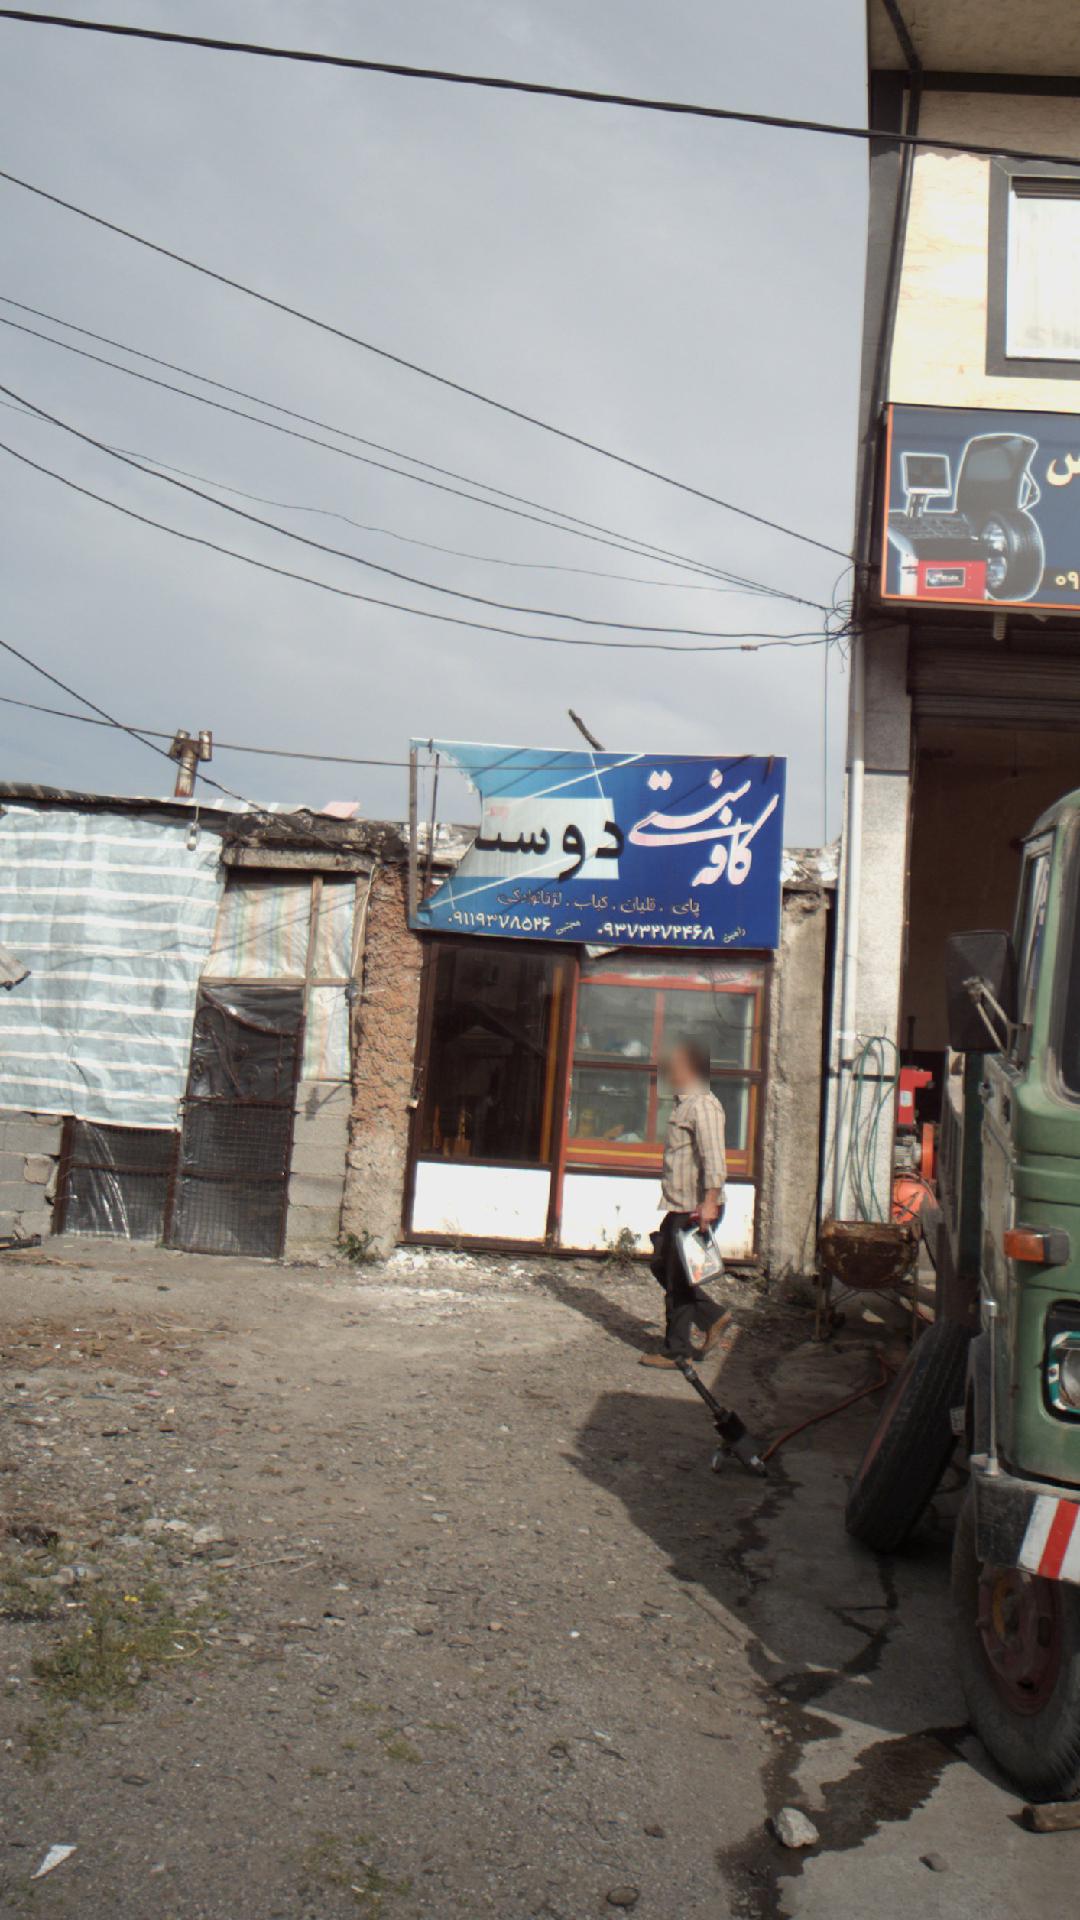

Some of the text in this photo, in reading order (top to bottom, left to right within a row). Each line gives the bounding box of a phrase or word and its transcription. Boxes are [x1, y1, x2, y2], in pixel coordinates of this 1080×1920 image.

[1055, 571, 1080, 591] ۰۹
[628, 768, 752, 847] سنتی
[691, 792, 780, 888] کافه
[573, 894, 609, 911] کباب
